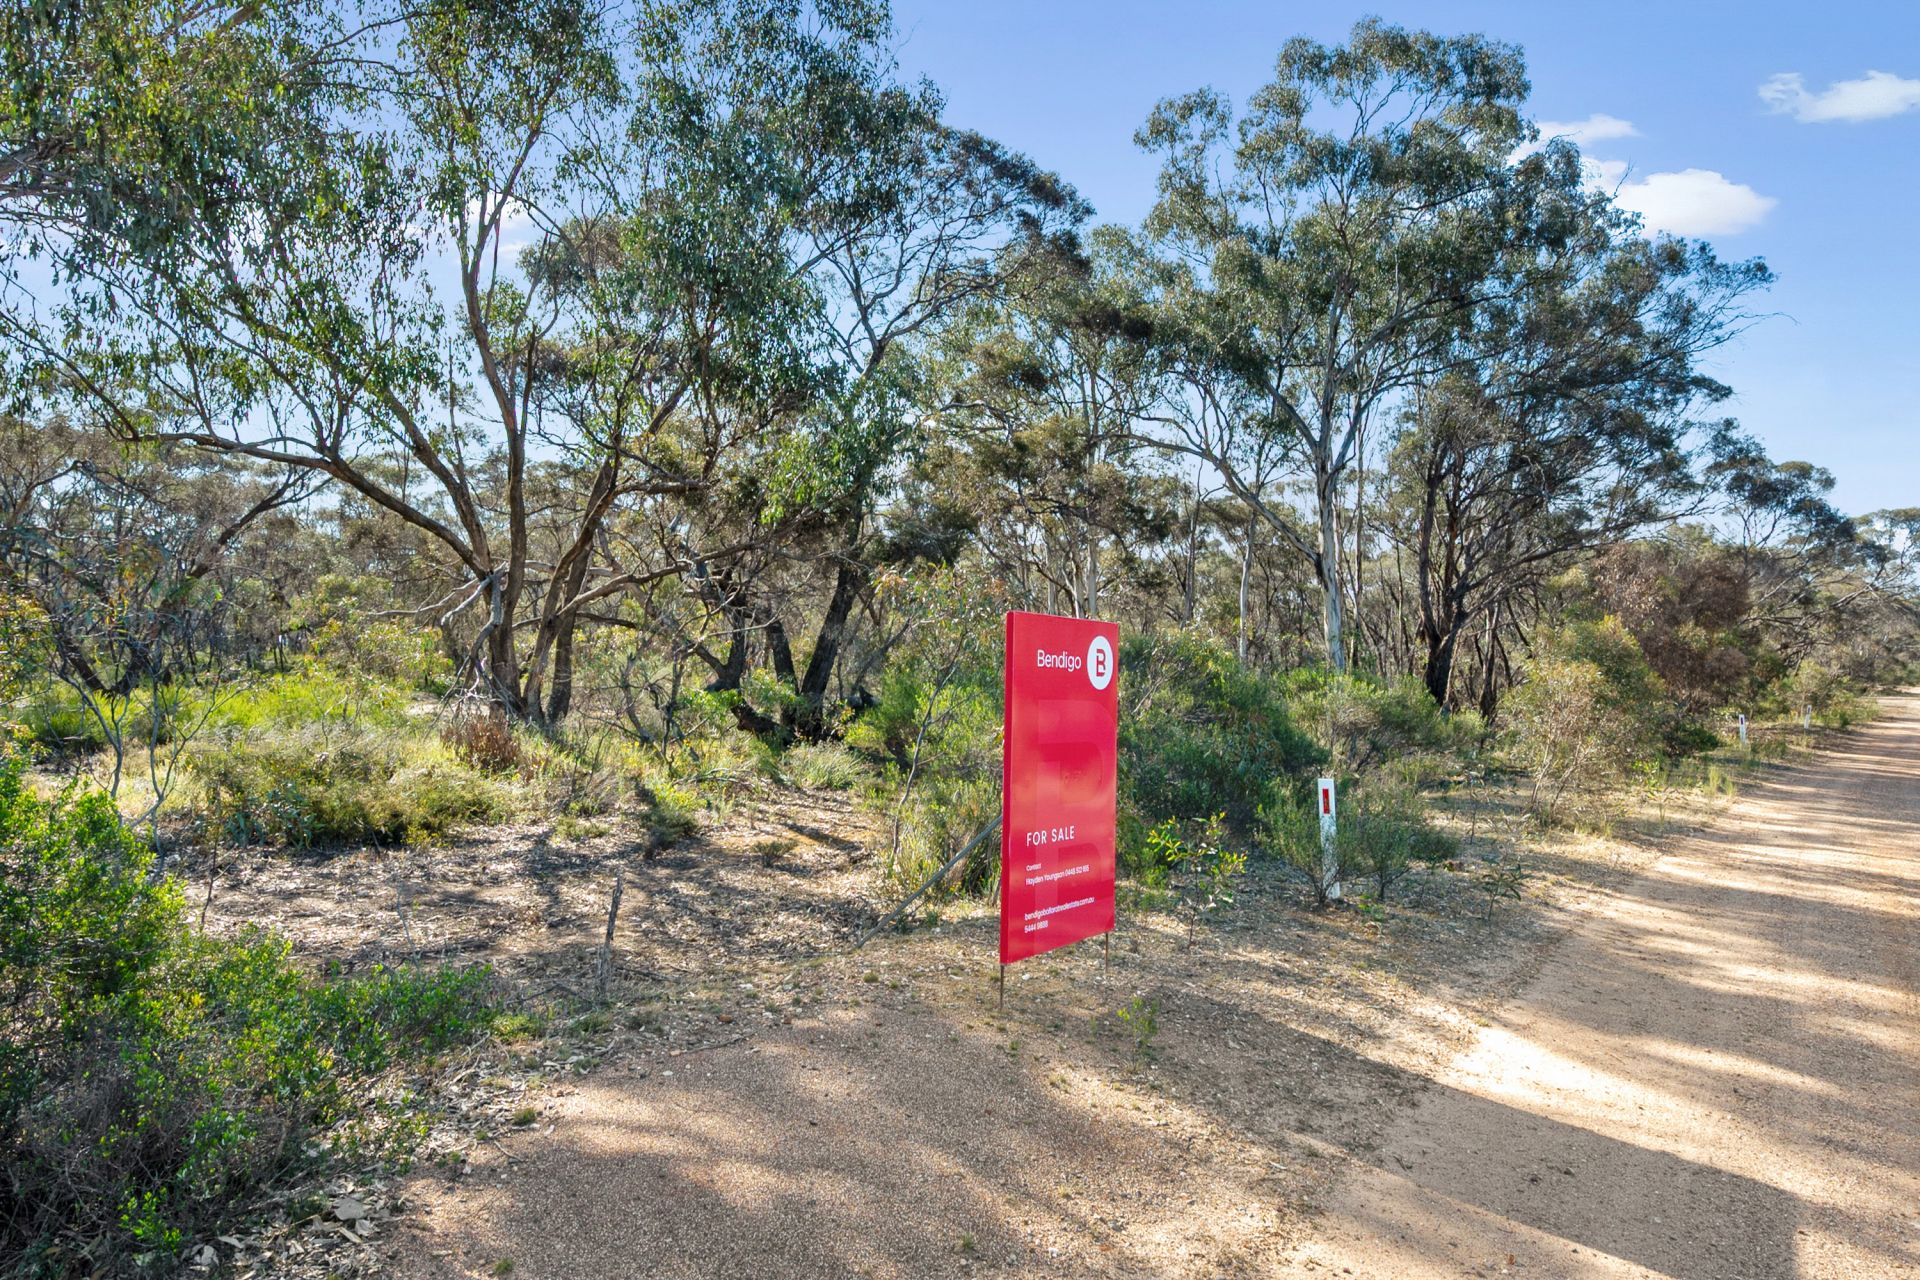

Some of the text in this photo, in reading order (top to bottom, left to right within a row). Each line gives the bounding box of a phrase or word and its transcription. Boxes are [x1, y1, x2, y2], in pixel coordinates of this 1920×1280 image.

[1037, 649, 1082, 672] Bendigo
[1026, 825, 1075, 847] FOR SALE
